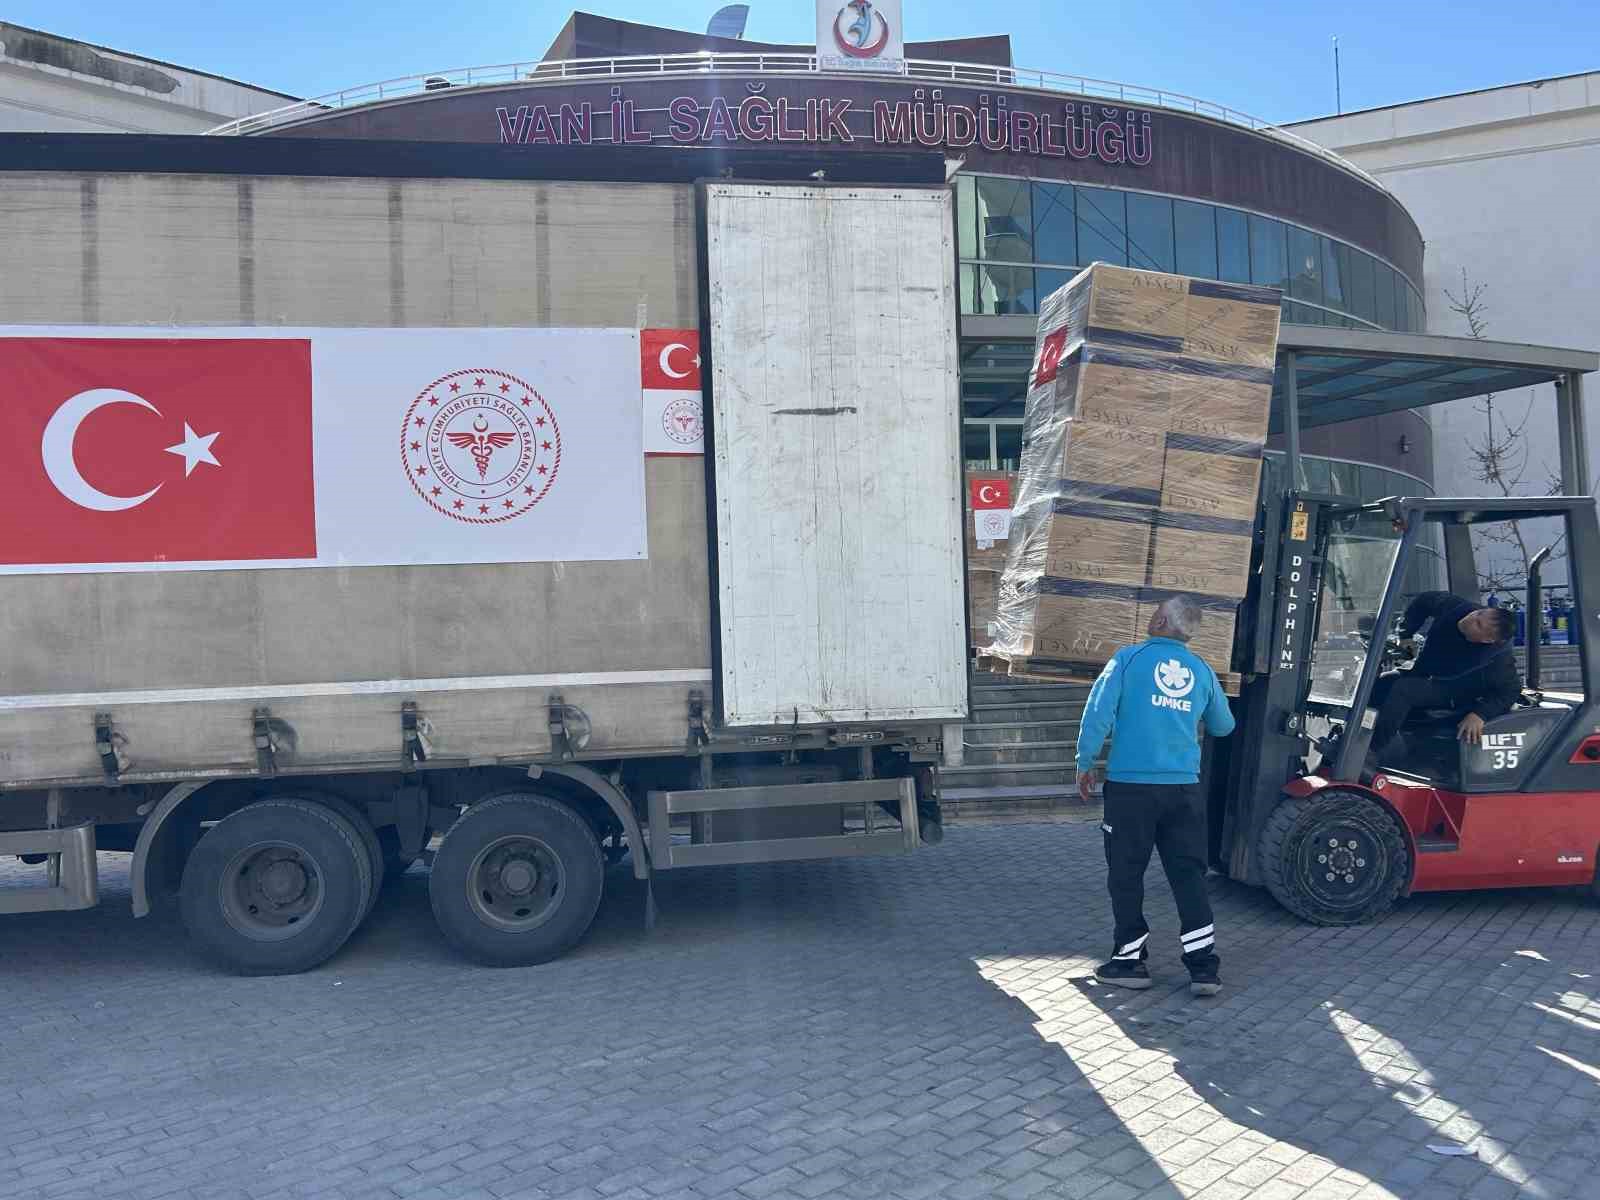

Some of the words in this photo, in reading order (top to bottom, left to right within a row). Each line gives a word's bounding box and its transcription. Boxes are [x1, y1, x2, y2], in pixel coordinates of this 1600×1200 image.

[496, 102, 592, 145] VAN
[610, 86, 652, 144] İL
[669, 81, 854, 142] SAĞLIK
[873, 88, 1152, 166] MÜDÜRLÜĞÜ
[431, 397, 490, 443] CUMHURİYETİ
[493, 400, 528, 430] SAĞLIK
[506, 431, 532, 488] BAKANLIĞI
[1281, 555, 1303, 661] DOLPHIN
[1151, 694, 1192, 712] UMKE
[1480, 732, 1527, 750] LIFT
[1493, 750, 1519, 769] 35
